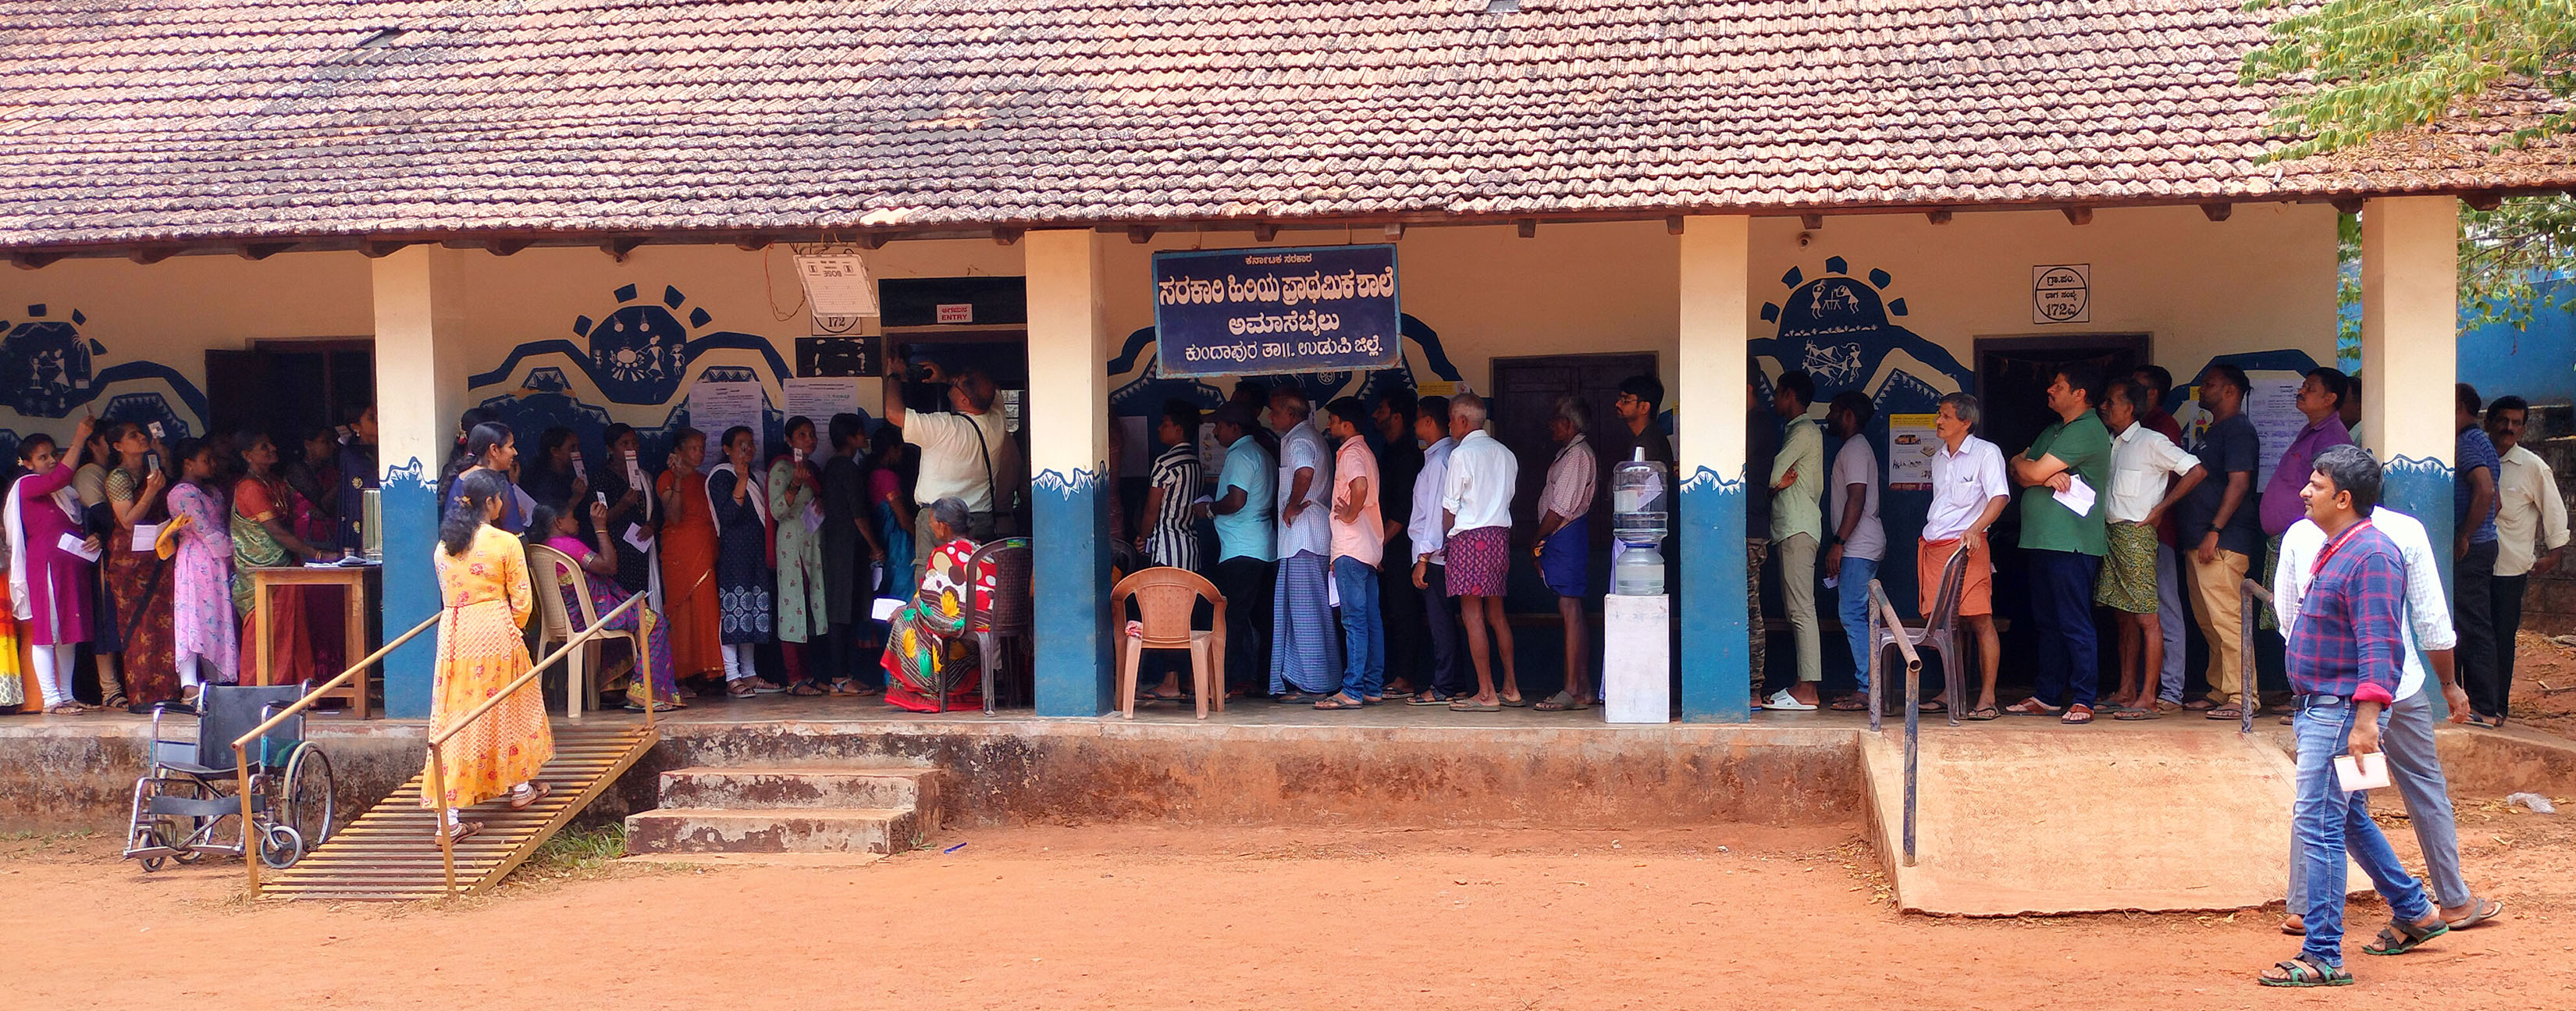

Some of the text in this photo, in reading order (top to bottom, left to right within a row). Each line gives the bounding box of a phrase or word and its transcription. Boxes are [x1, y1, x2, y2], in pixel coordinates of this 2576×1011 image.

[1245, 252, 1312, 265] ಕರ್ನಾಟಕ ಸರಕಾರ
[1158, 265, 1394, 306] ಸರಕಾರಿ ಹಿರಿಯ ಪ್ರಾಥಮಿಕ ಶಾಲೆ
[1228, 309, 1340, 337] ಅಮಾಸೆಬೈಲು
[1185, 340, 1258, 362] ಕುಂದಾಪುರ
[1297, 336, 1352, 356] ಉಡುಪಿ
